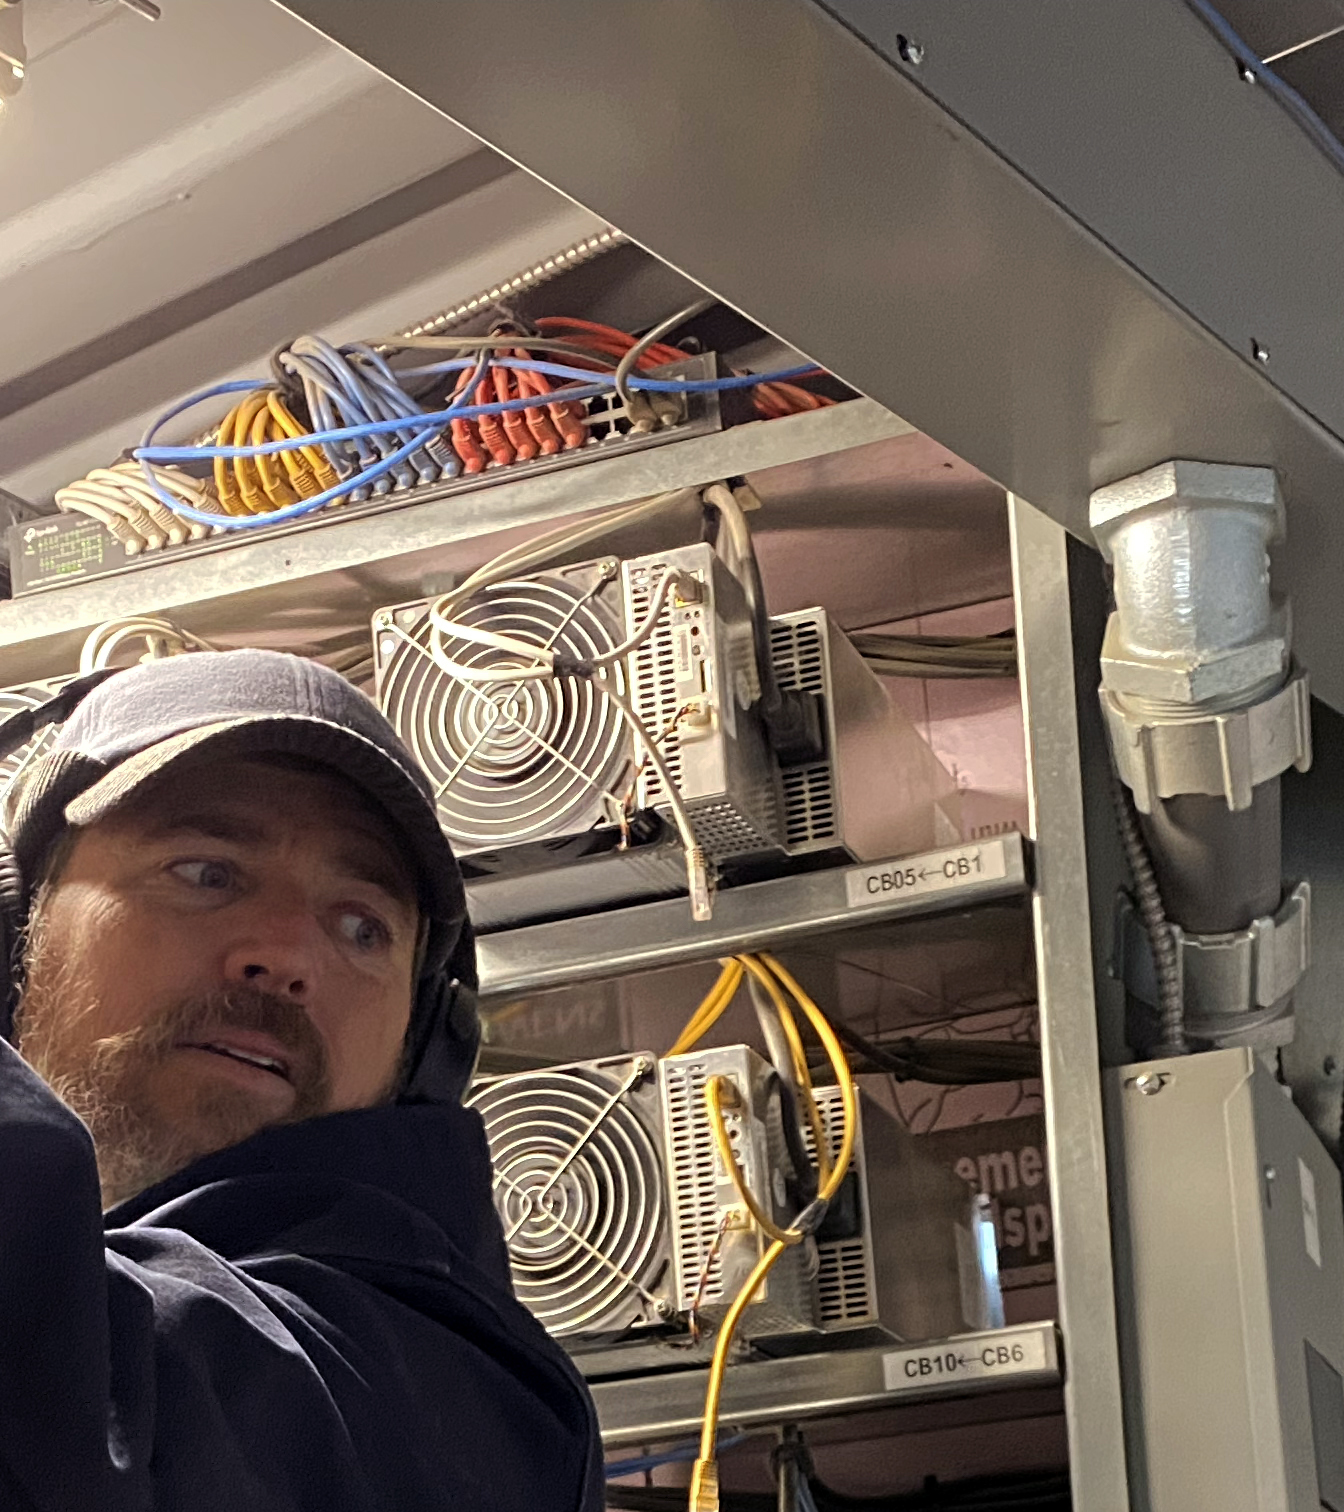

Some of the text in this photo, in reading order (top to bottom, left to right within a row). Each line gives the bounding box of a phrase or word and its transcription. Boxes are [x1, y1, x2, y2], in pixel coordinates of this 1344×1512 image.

[866, 854, 982, 894] CB05 CB1
[904, 1343, 1024, 1378] CB10 CB6
